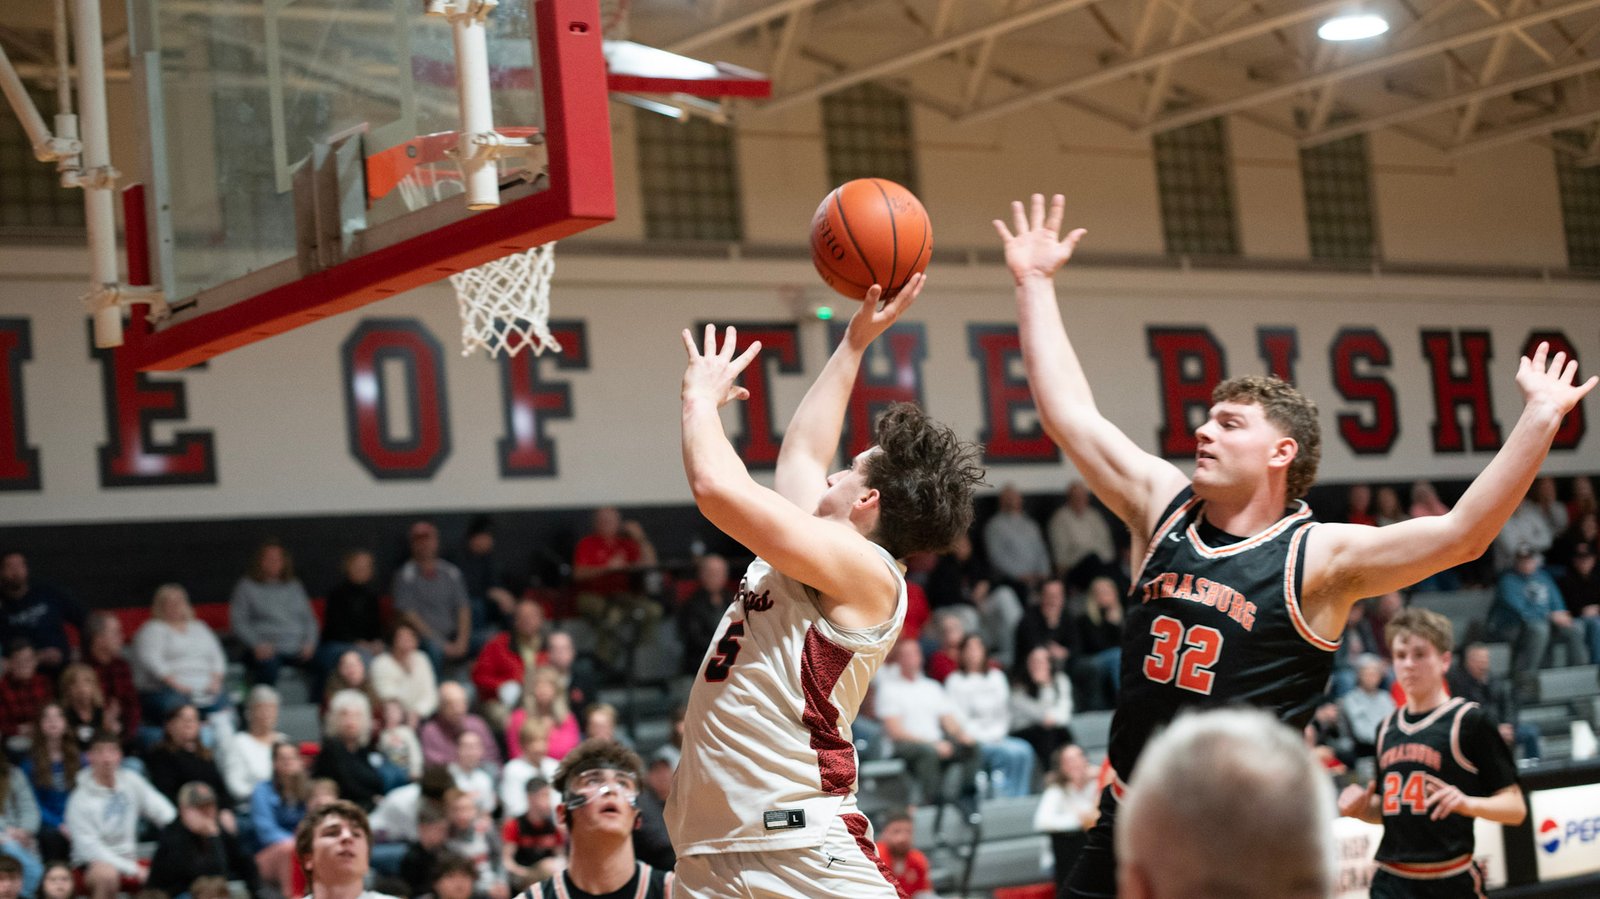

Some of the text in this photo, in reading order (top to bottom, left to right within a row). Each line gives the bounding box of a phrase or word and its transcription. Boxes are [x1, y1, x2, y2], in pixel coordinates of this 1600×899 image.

[0, 316, 218, 490] E
[341, 317, 590, 480] OF
[695, 319, 1062, 471] THE
[704, 619, 744, 682] 5
[1143, 615, 1224, 696] 32
[1383, 771, 1427, 816] 24
